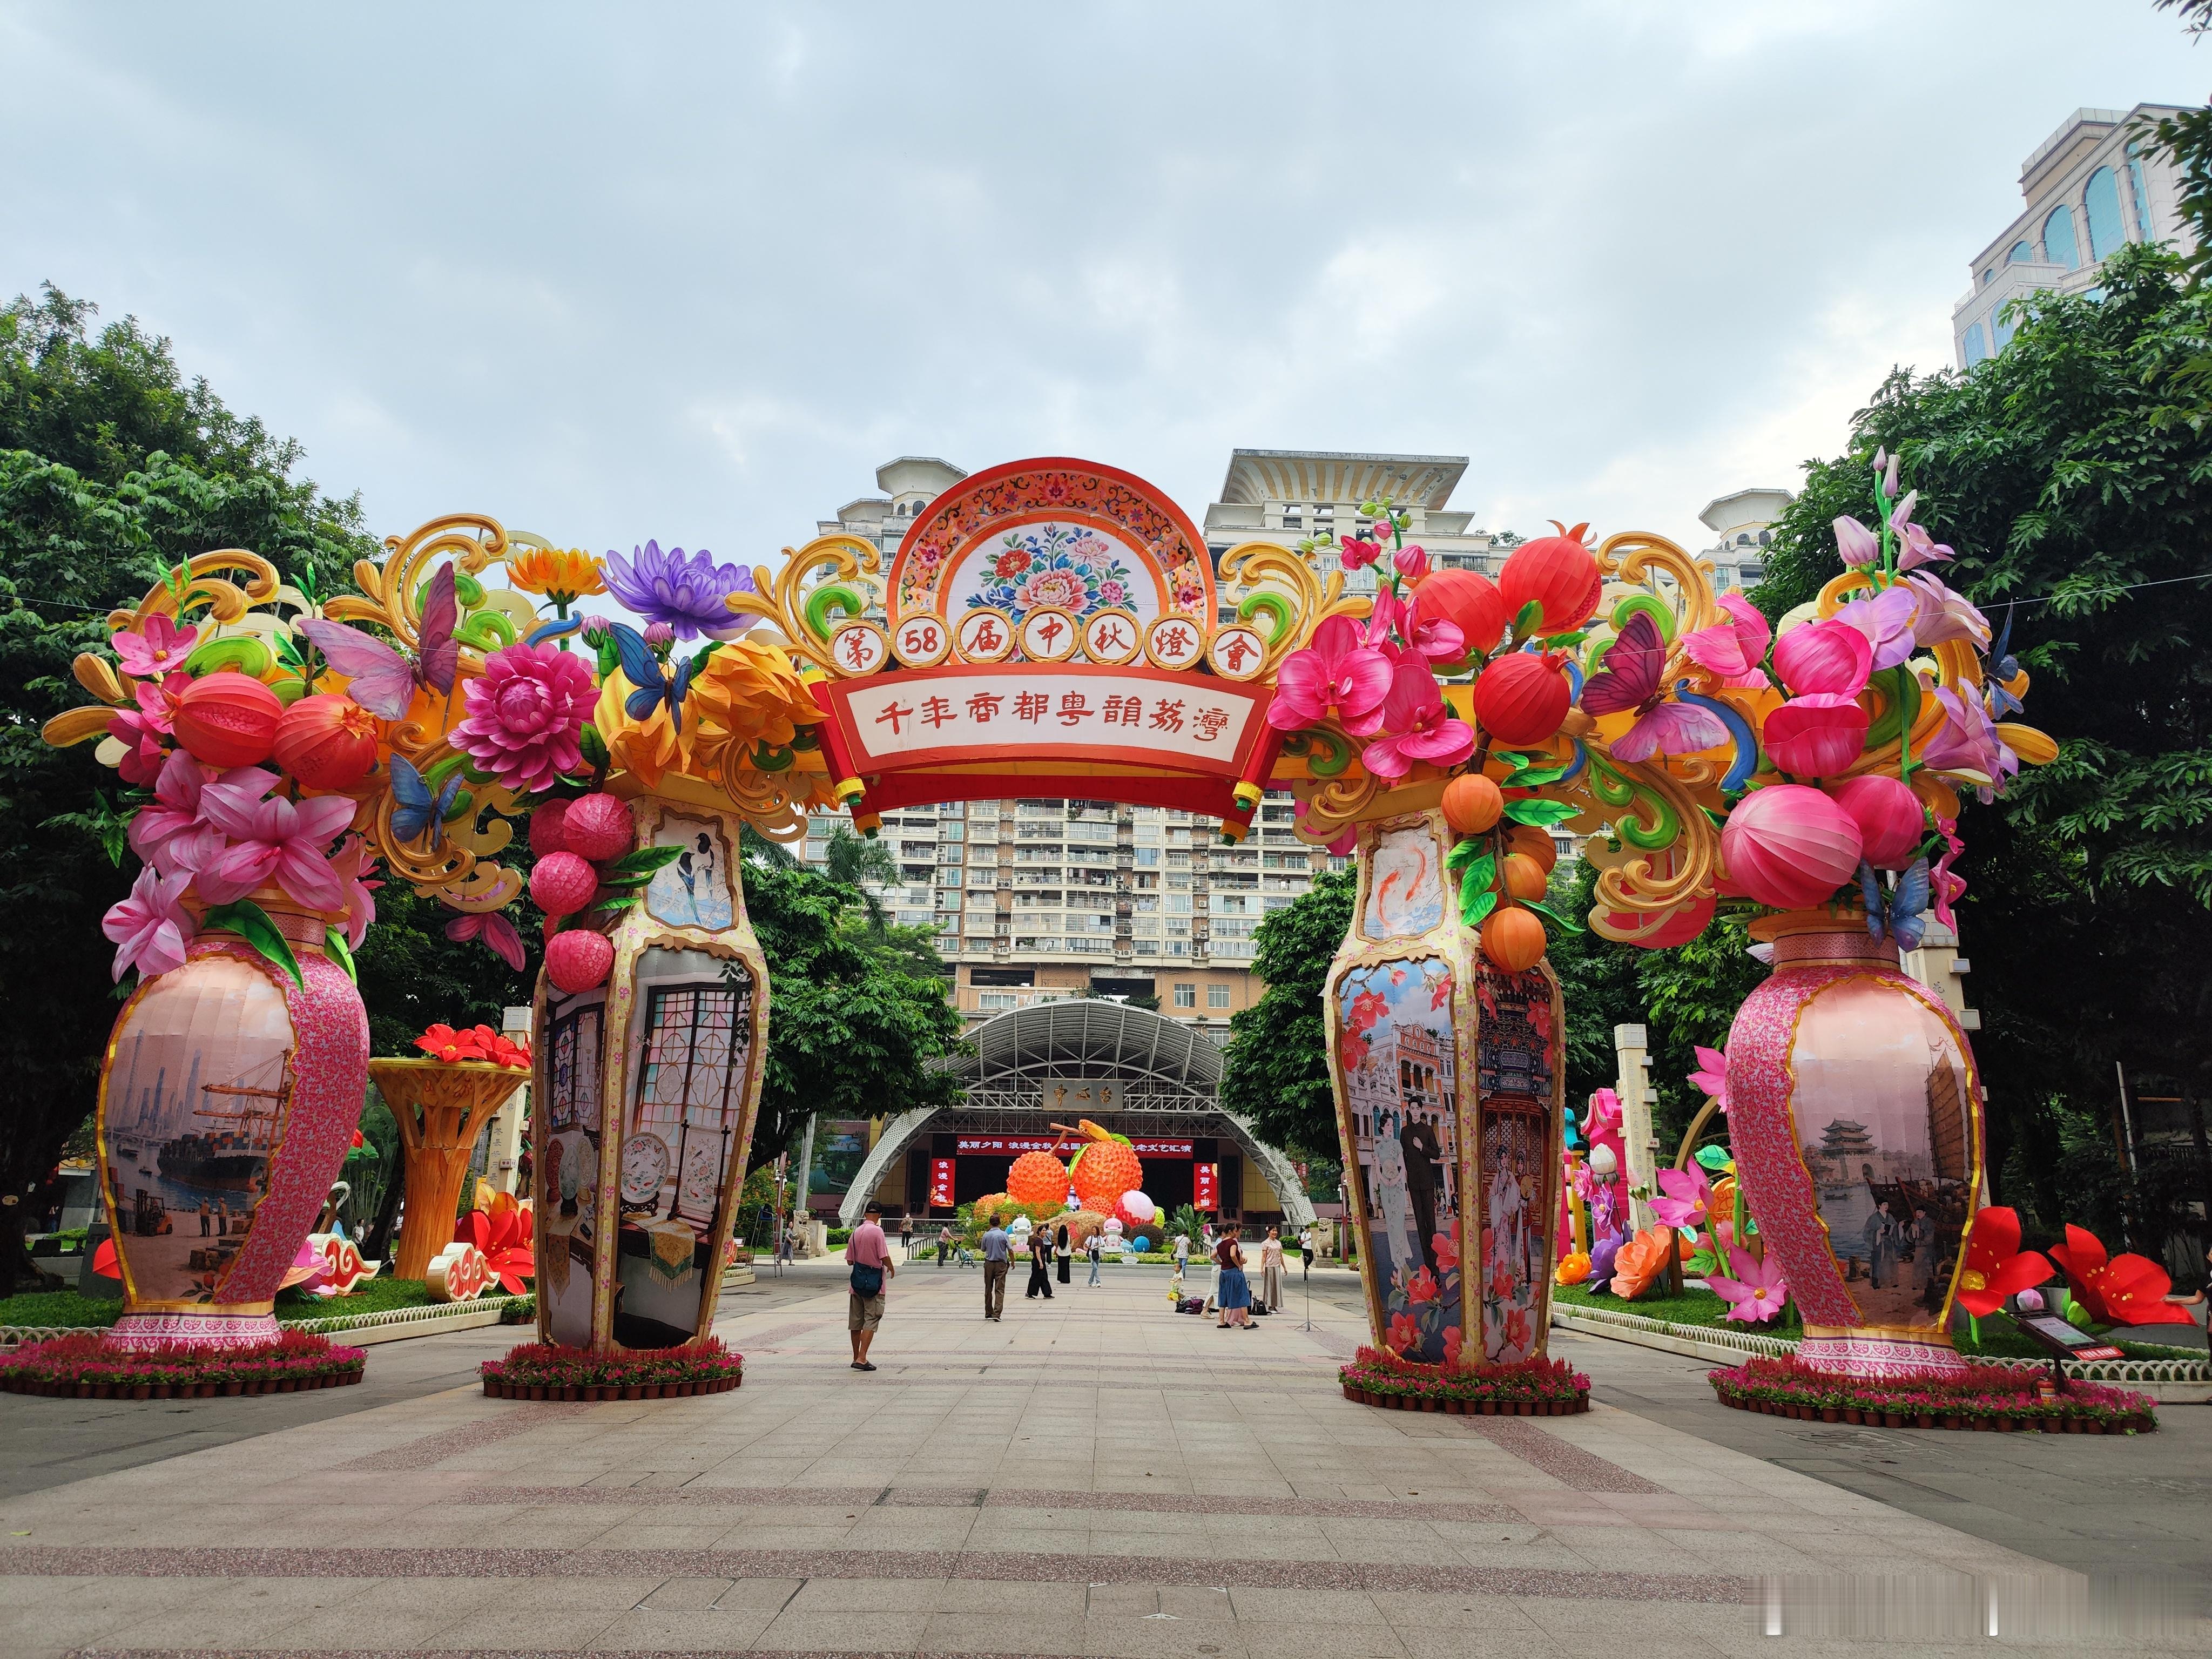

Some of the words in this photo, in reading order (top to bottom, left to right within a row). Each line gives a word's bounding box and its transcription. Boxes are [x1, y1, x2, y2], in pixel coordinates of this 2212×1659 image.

[844, 616, 1259, 672] 第58届中秋燈會
[958, 1141, 1002, 1149] 美丽夕阳
[1008, 1142, 1053, 1150] 浪漫金秋
[937, 1161, 949, 1203] 浪漫金秋
[1199, 1165, 1210, 1206] 美丽夕阳
